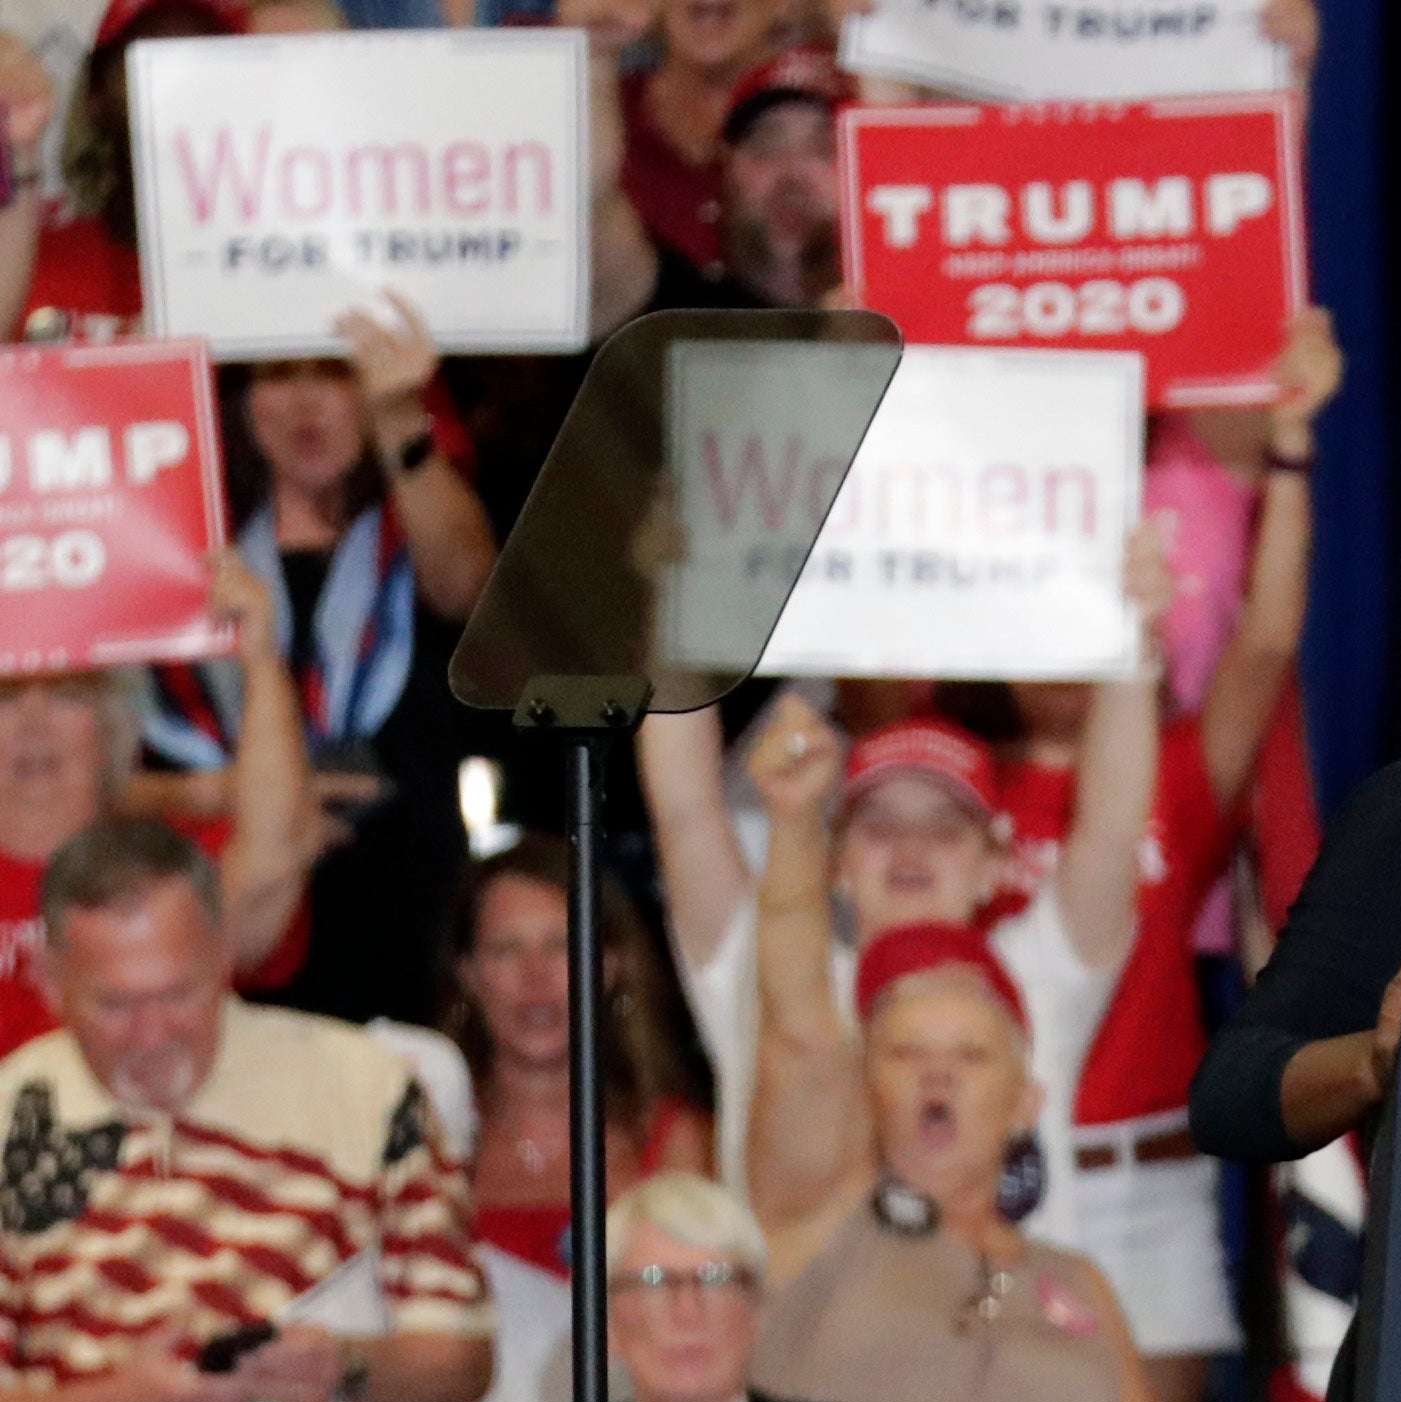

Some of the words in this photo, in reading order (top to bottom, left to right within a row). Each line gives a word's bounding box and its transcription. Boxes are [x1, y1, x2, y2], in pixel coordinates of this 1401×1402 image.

[1044, 3, 1217, 40] TRUMP
[172, 122, 556, 226] Women
[865, 172, 1275, 248] TRUMP
[223, 235, 330, 270] FOR
[353, 229, 522, 266] TRUMP
[965, 276, 1187, 340] 2020
[702, 429, 1098, 538] Women
